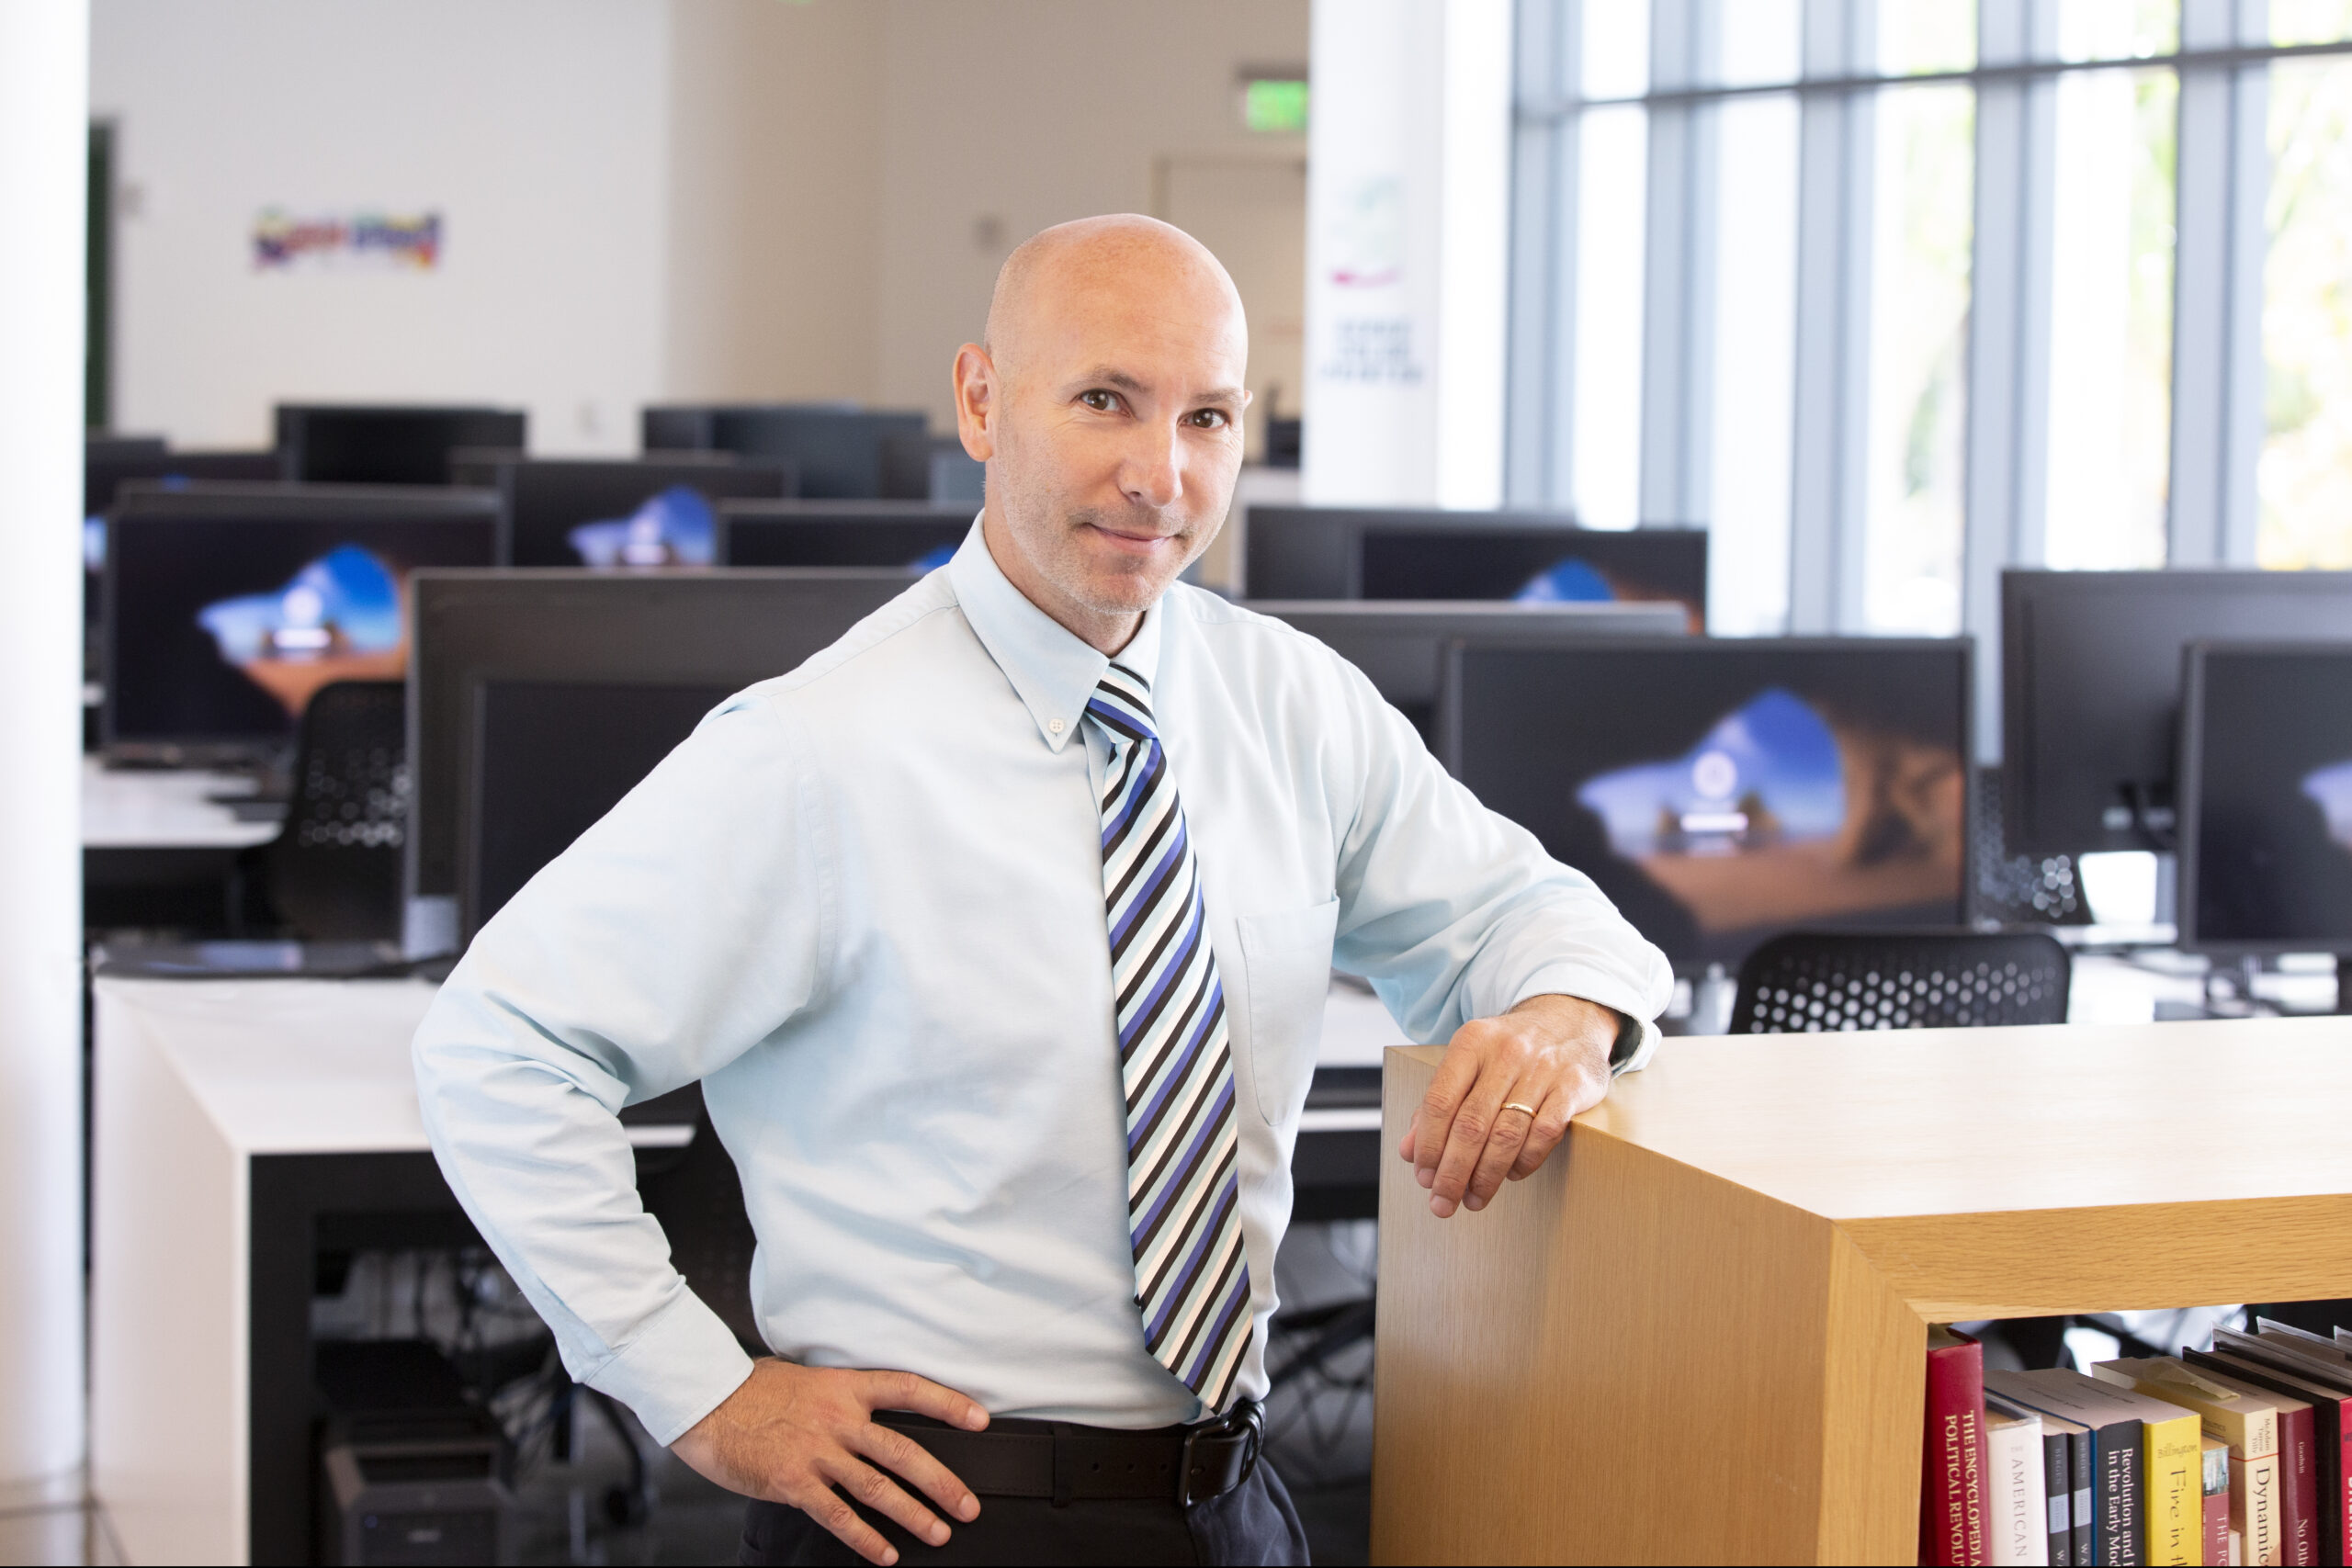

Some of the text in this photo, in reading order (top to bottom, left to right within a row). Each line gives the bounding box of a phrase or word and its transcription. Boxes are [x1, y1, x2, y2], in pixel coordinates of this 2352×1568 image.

[2109, 1450, 2120, 1465] in
[2109, 1468, 2120, 1492] the
[1945, 1415, 1964, 1566] POLITICAL REVOLU
[1962, 1410, 1982, 1566] THE ENCYCLOPEDIA
[2012, 1459, 2028, 1557] AMERICAN
[2121, 1448, 2134, 1528] Revolution
[2169, 1466, 2187, 1520] Fire
[2106, 1495, 2121, 1532] Early
[2170, 1527, 2186, 1548] in
[2216, 1514, 2227, 1544] THE
[2253, 1467, 2274, 1566] Dynamic
[2122, 1530, 2135, 1558] and
[2297, 1517, 2310, 1566] No Oth
